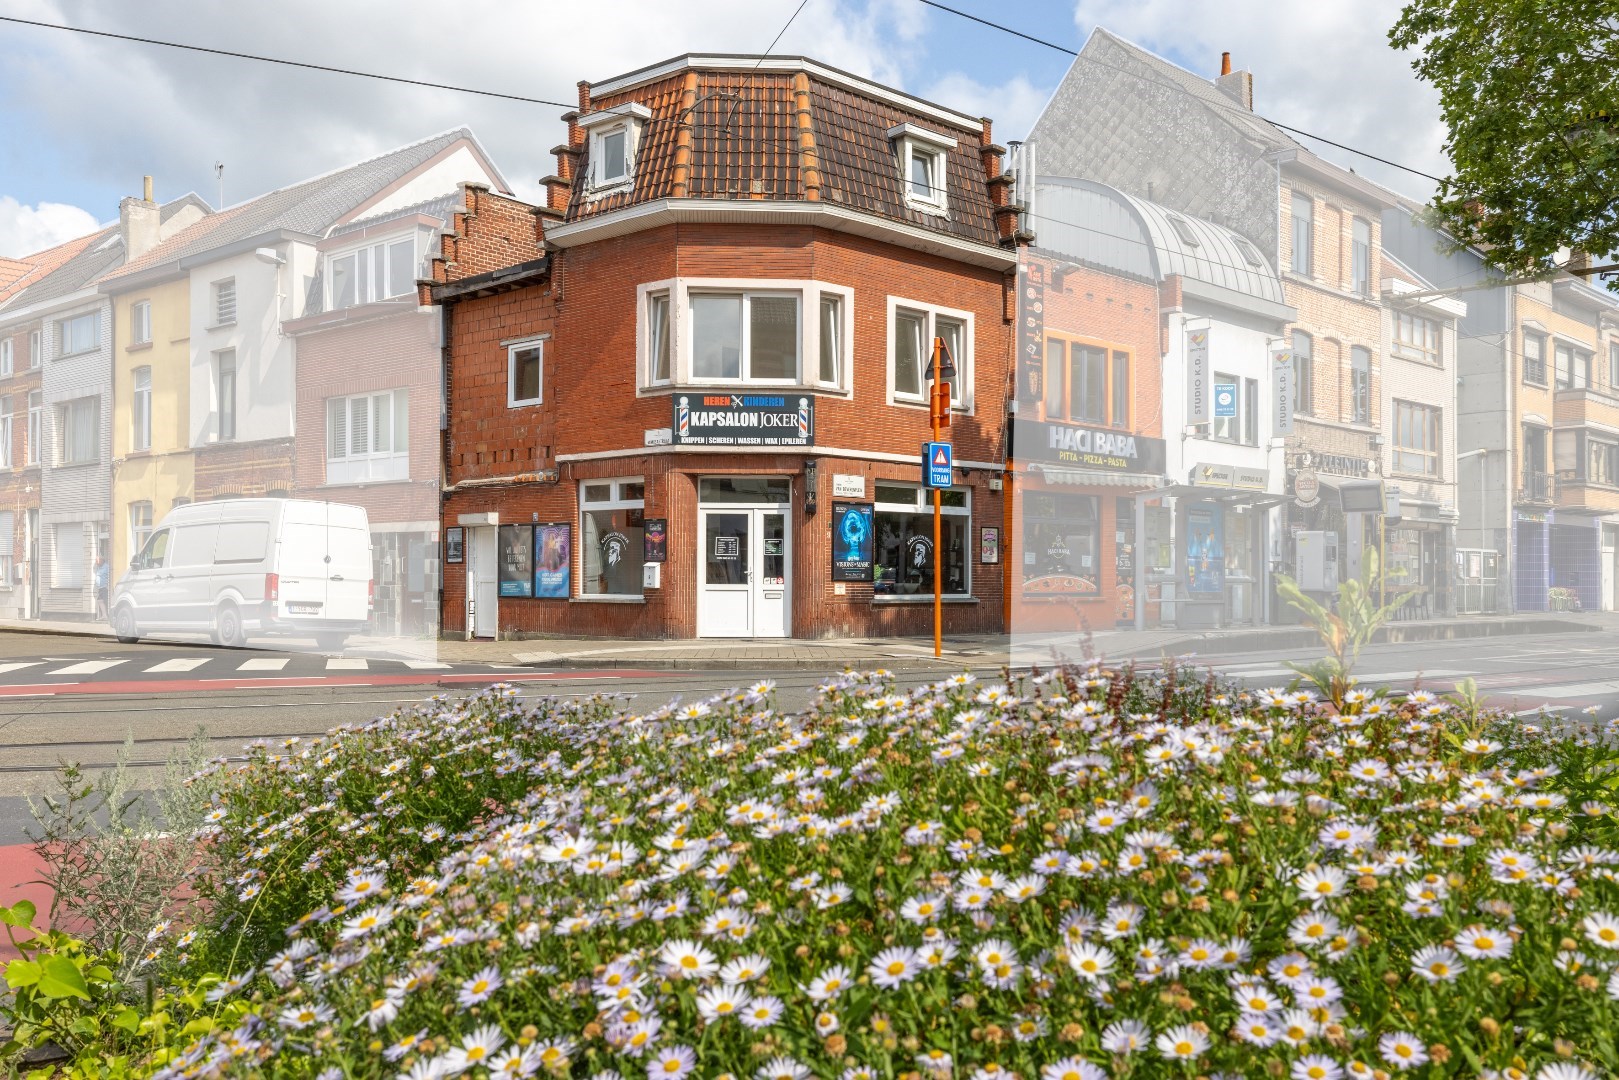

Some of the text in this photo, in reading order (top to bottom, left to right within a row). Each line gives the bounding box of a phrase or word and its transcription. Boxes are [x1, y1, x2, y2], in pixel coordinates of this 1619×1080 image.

[703, 397, 785, 407] HEREN KINDEREN
[1279, 373, 1287, 428] STUDIO K.D.
[690, 411, 799, 429] KAPSALON JOKER
[737, 437, 761, 445] WASSEN
[764, 437, 778, 445] WAX
[781, 437, 807, 445] EPILEREN
[1049, 425, 1138, 459] HACI BABA
[1059, 451, 1127, 468] PITTA PIZZA PASTA
[933, 474, 949, 484] TRAM
